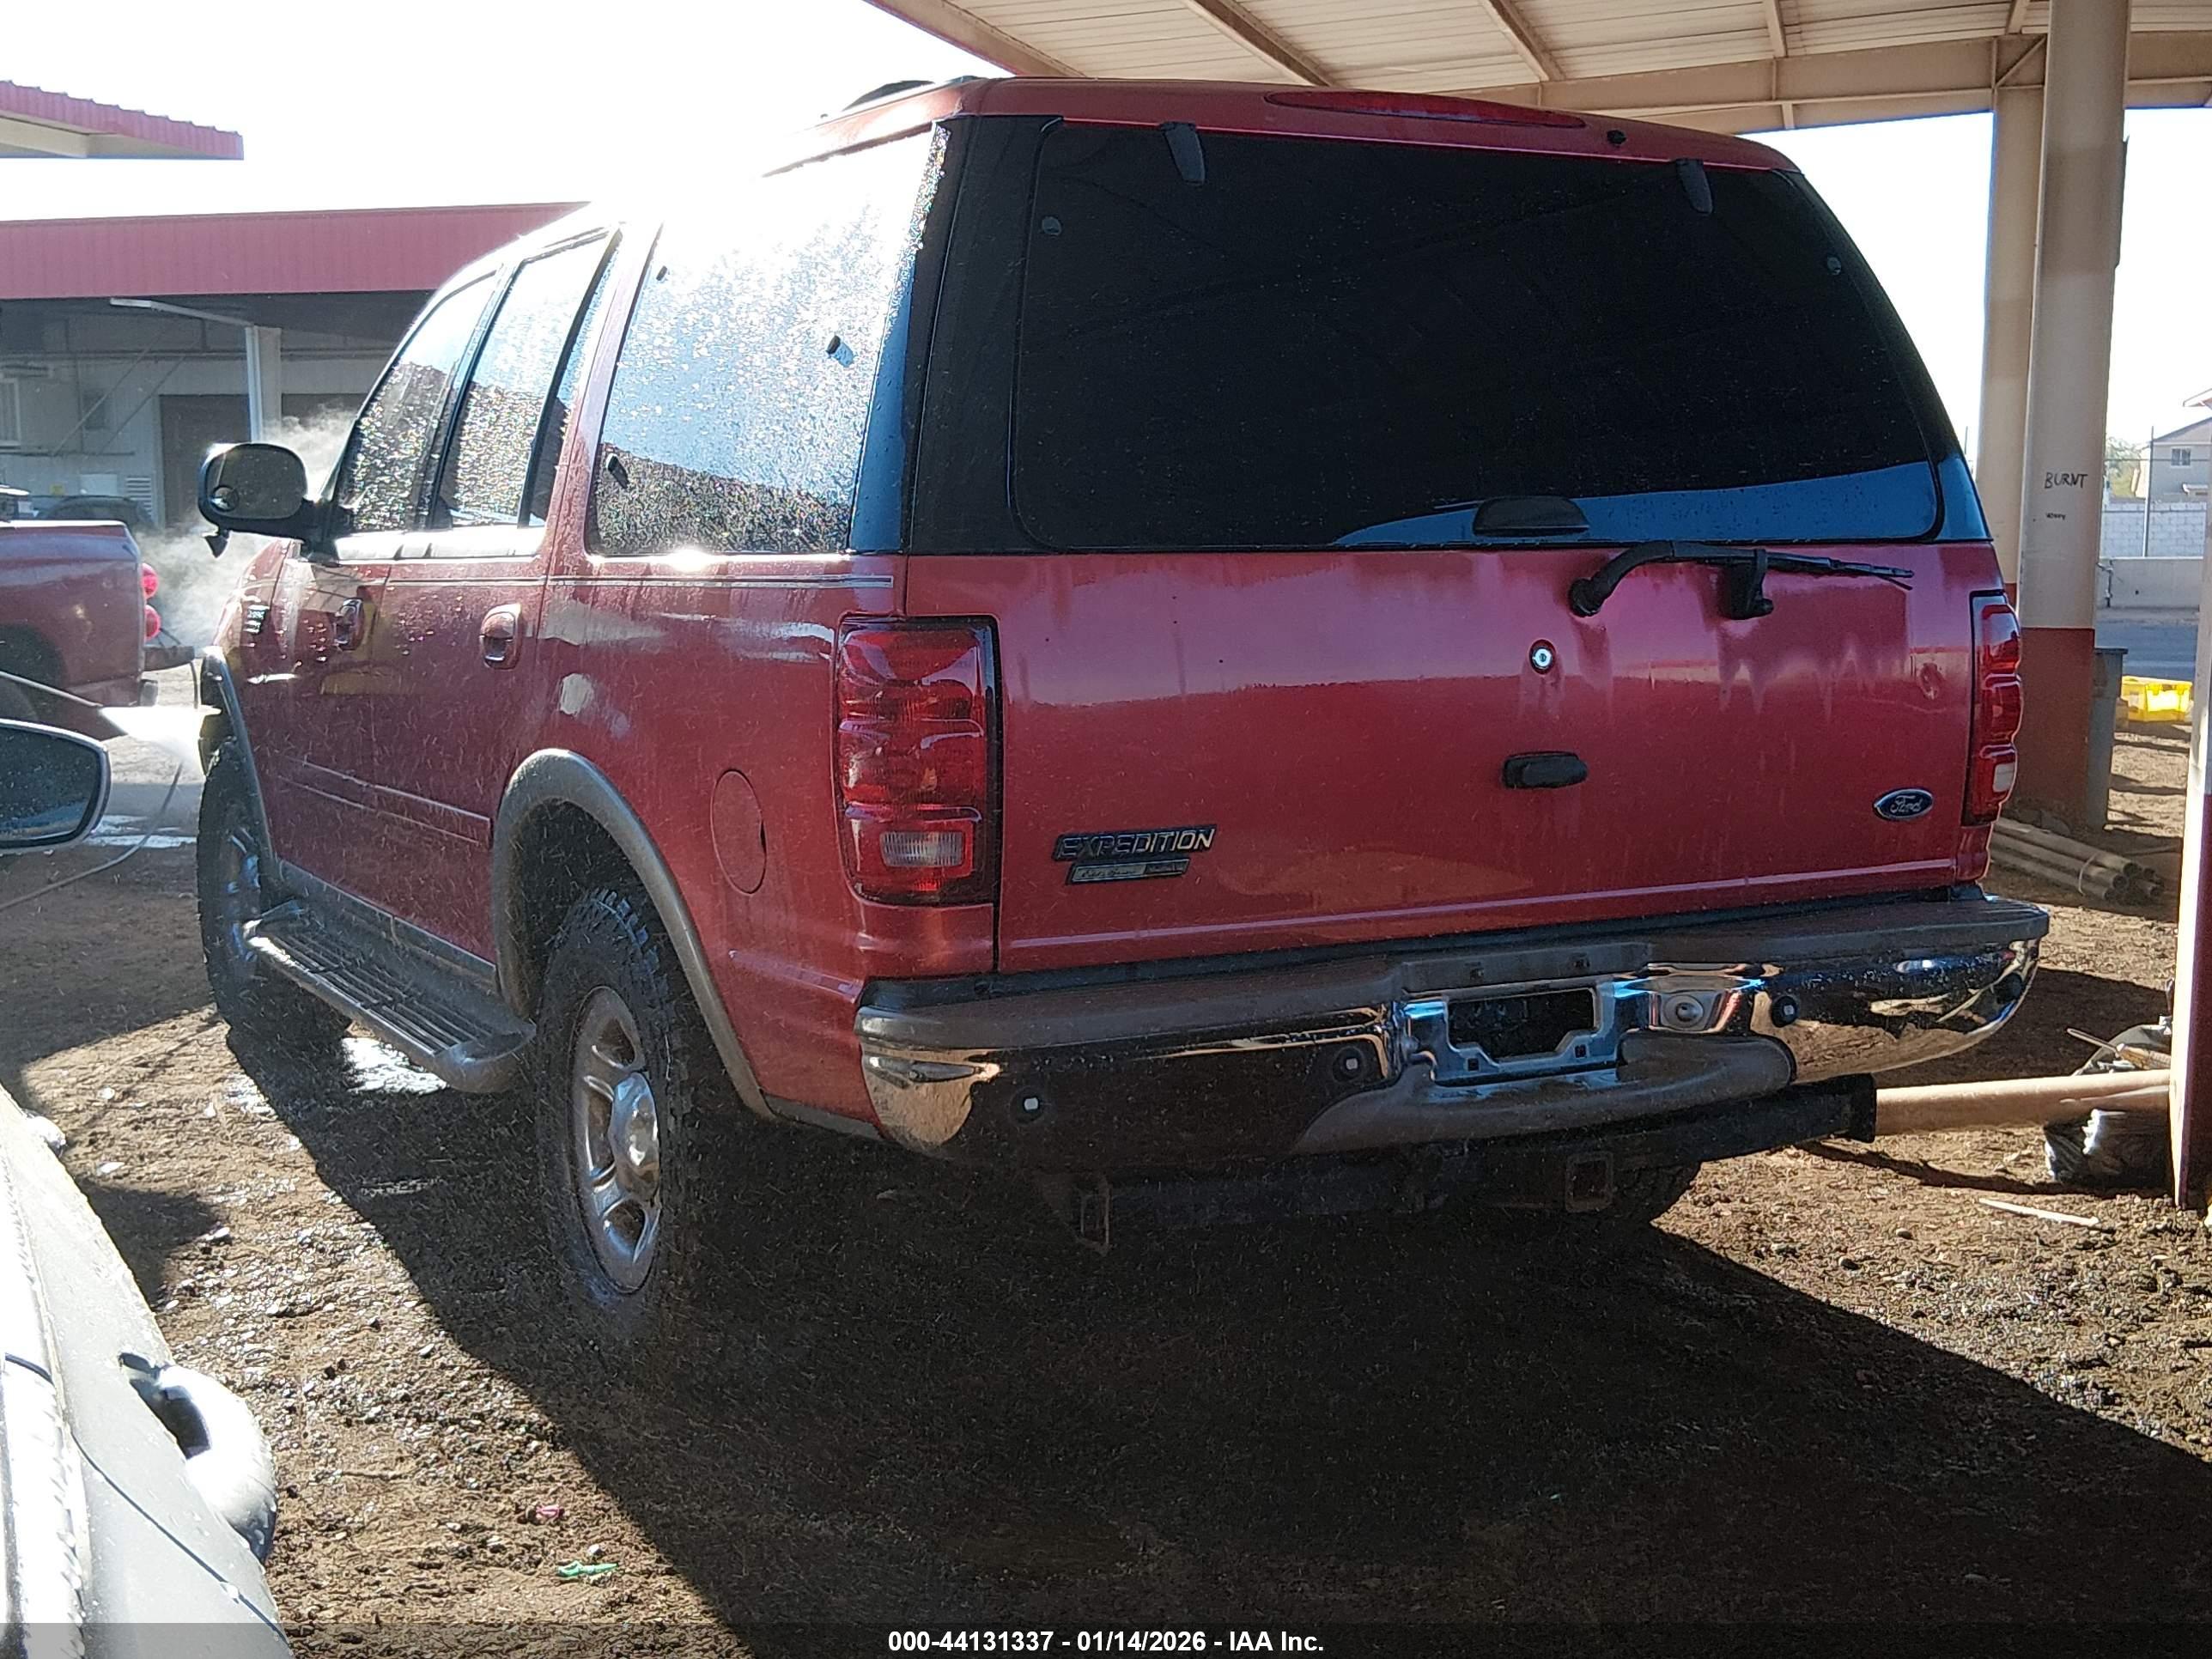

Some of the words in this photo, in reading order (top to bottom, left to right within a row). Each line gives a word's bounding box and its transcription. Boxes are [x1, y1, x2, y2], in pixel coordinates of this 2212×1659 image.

[2045, 471, 2088, 489] BURNT
[1890, 795, 1923, 813] Ford
[1057, 827, 1216, 860] EXPEDITION
